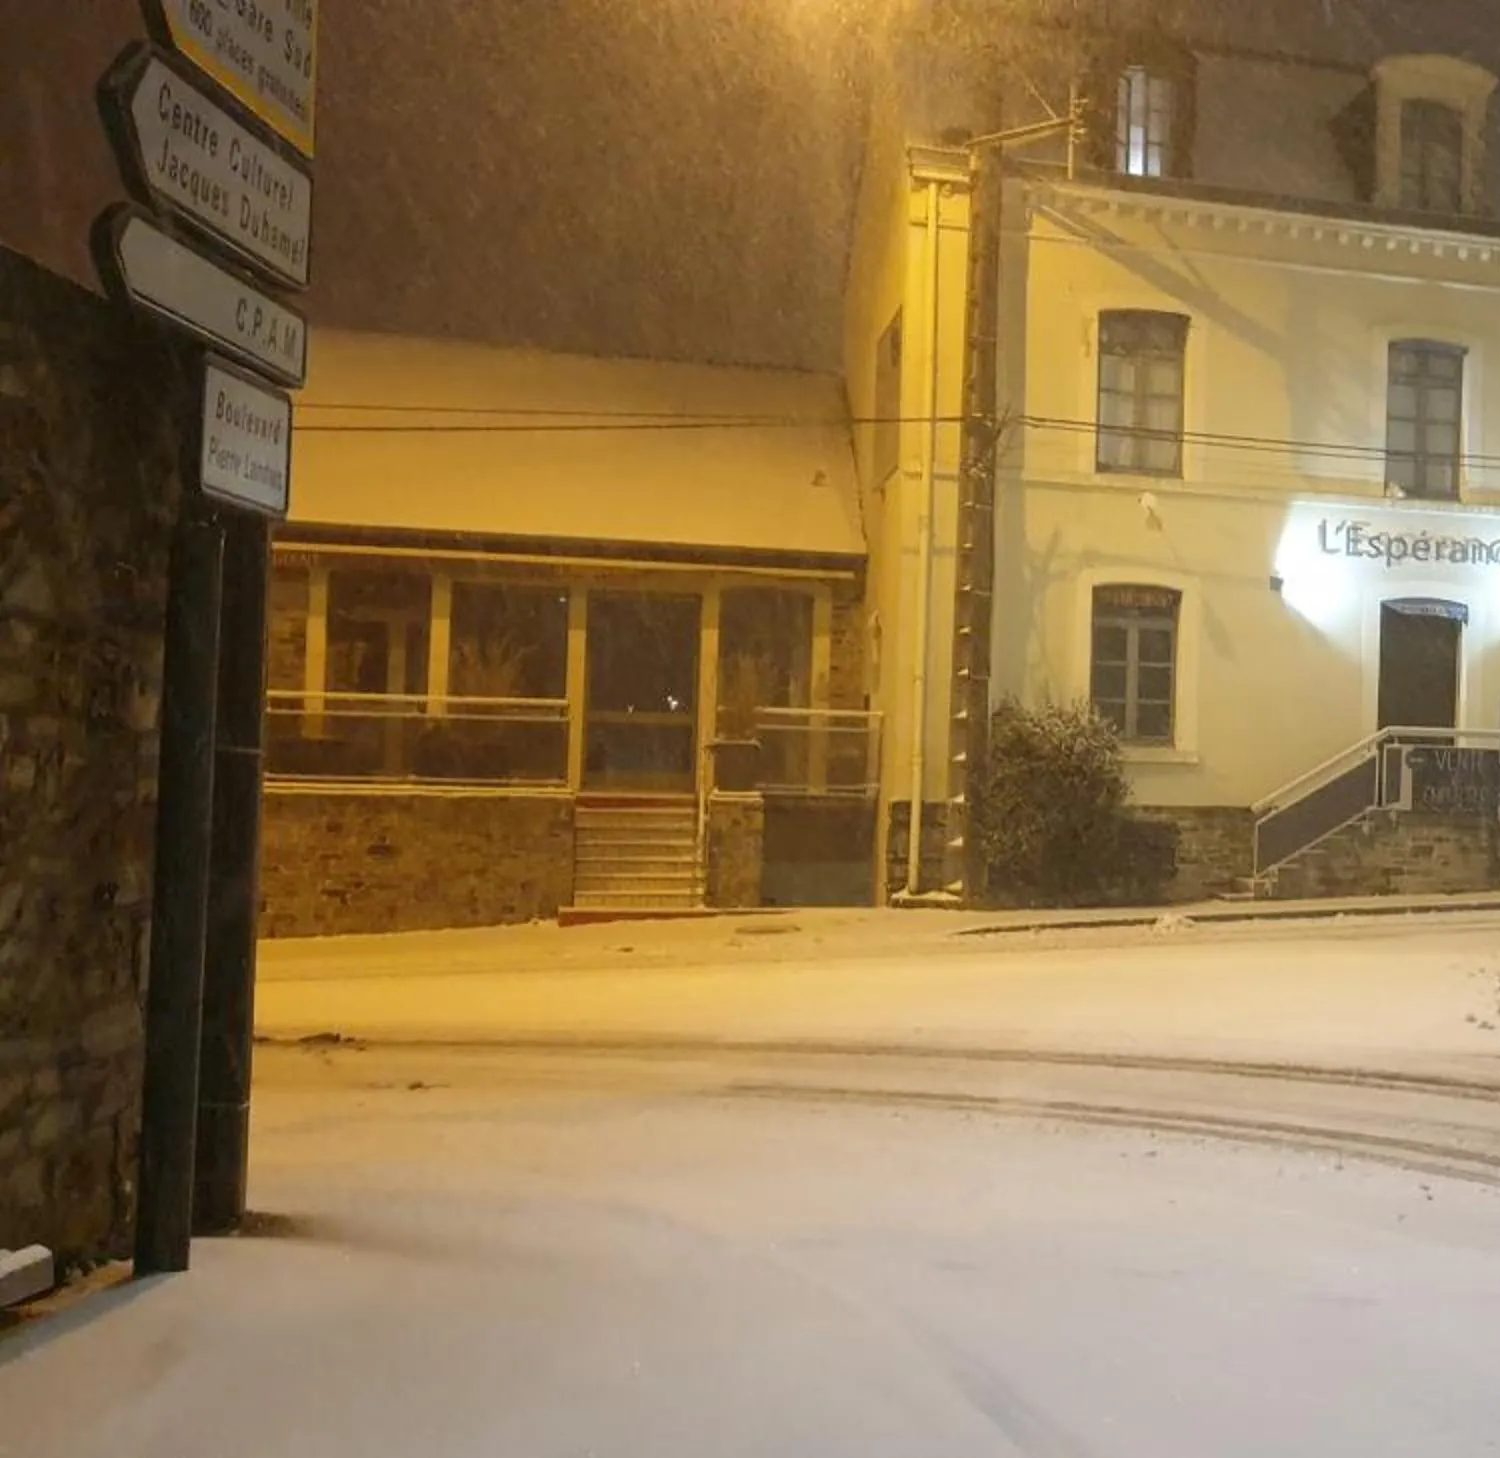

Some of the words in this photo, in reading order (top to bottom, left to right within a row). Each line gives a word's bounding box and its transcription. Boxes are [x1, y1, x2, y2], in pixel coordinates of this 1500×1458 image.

[284, 29, 313, 79] Sud
[157, 81, 219, 158] Centre
[228, 137, 295, 213] Culturel
[156, 138, 231, 218] Jacques
[239, 193, 307, 266] Duhamel
[215, 390, 283, 446] Boulevard
